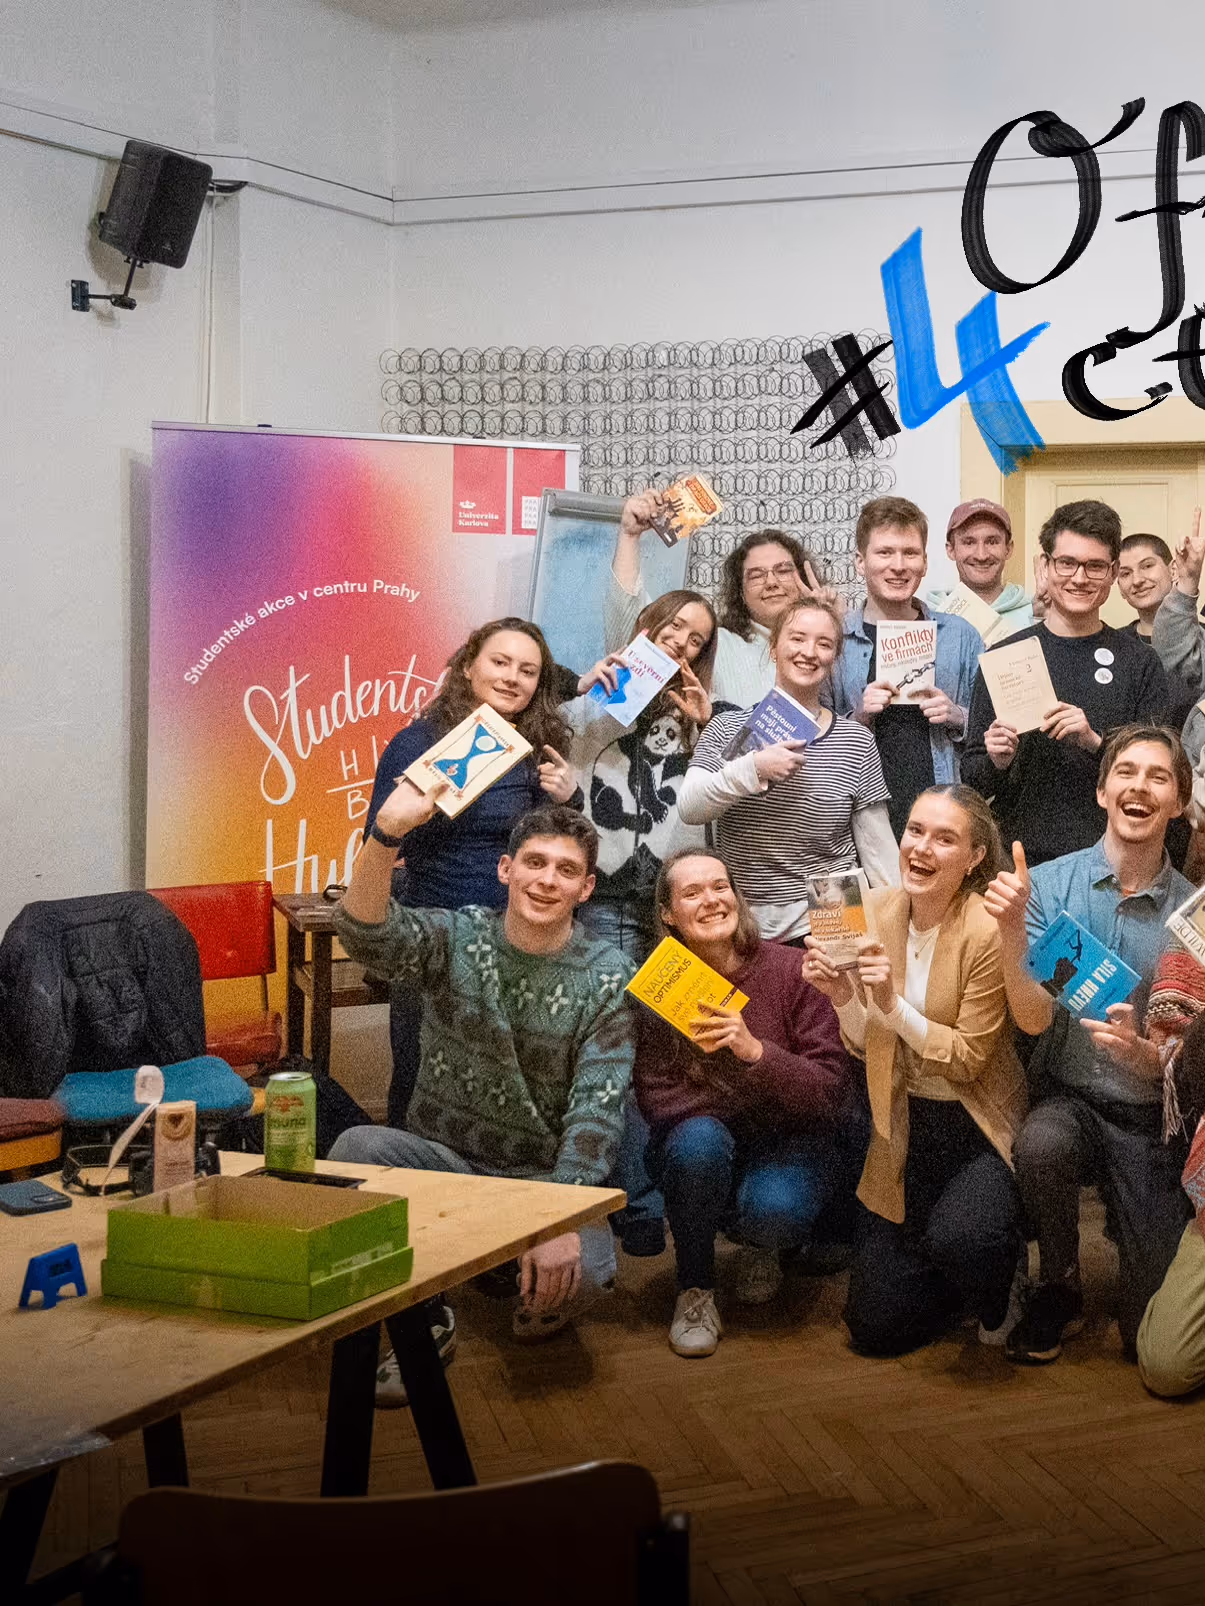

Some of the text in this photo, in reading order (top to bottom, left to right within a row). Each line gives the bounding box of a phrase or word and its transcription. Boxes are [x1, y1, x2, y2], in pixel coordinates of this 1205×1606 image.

[459, 512, 499, 520] Univerzita
[184, 580, 421, 685] Studentské akce v centru Prahy
[881, 628, 934, 651] Konflikty
[882, 653, 893, 663] ve
[895, 642, 933, 660] firmách
[755, 720, 765, 729] na
[760, 713, 796, 741] mají práv
[766, 705, 797, 732] Pěstouni
[812, 908, 841, 919] Zdraví
[653, 958, 692, 1003] OPTIMISMUS
[671, 1000, 684, 1016] Jak
